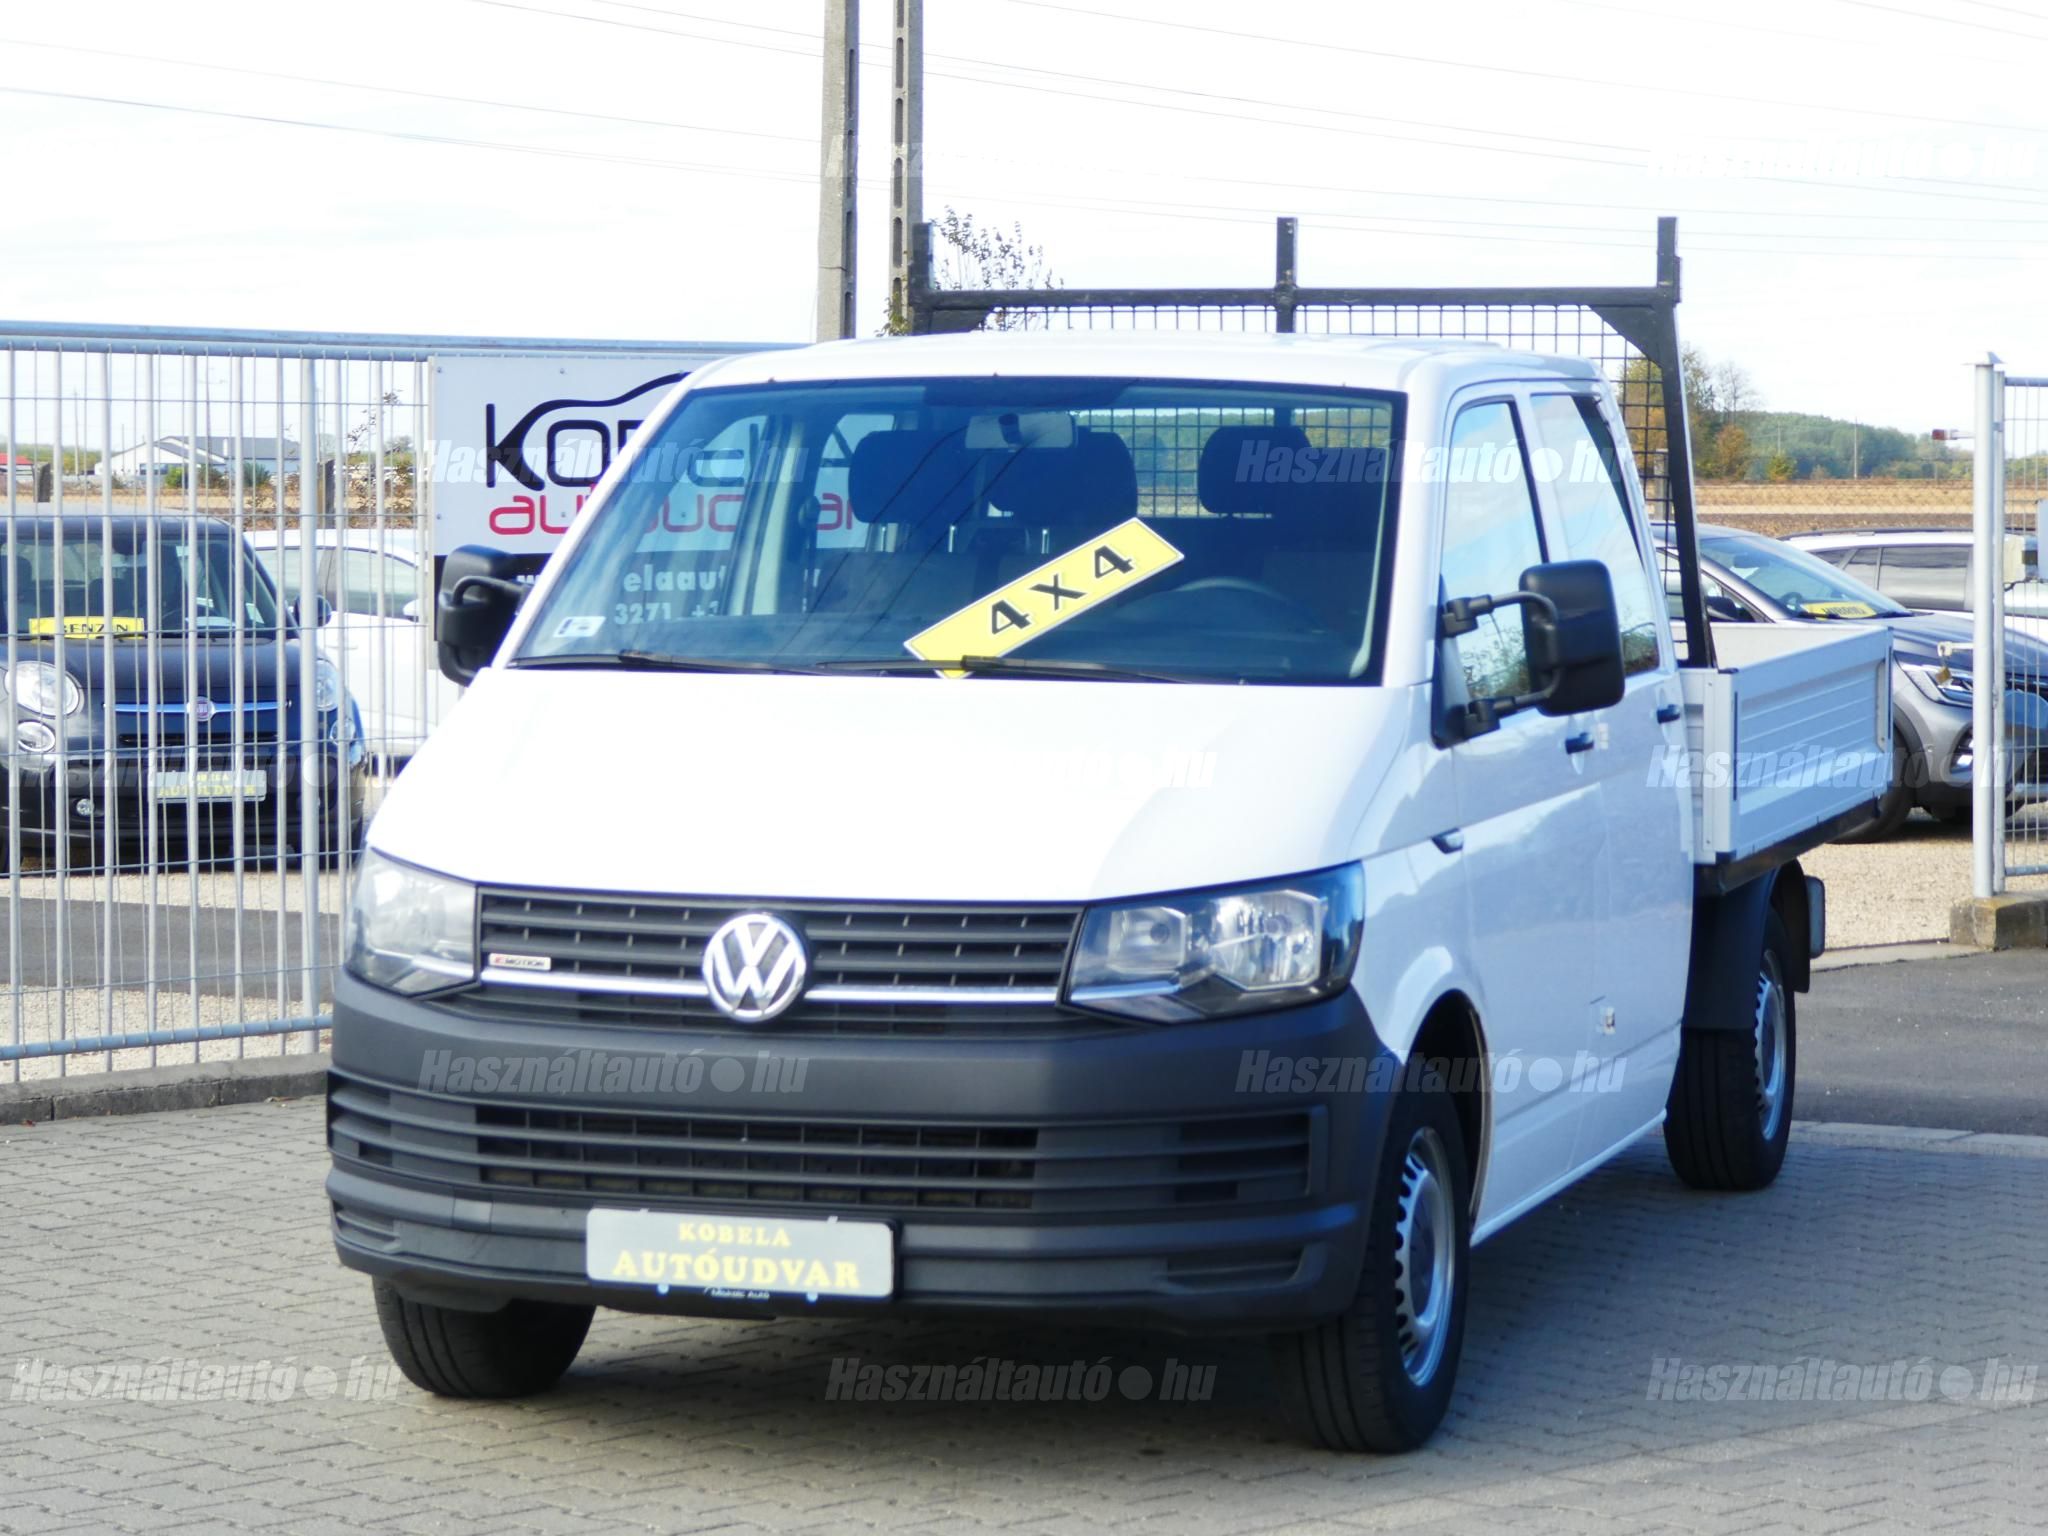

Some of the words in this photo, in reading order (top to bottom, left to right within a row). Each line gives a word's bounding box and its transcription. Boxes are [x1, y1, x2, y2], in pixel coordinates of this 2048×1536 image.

[991, 600, 1031, 635] 4
[1094, 545, 1134, 579] 4
[678, 1222, 792, 1248] KOBELA
[612, 1248, 861, 1289] AUTÓUDVAR
